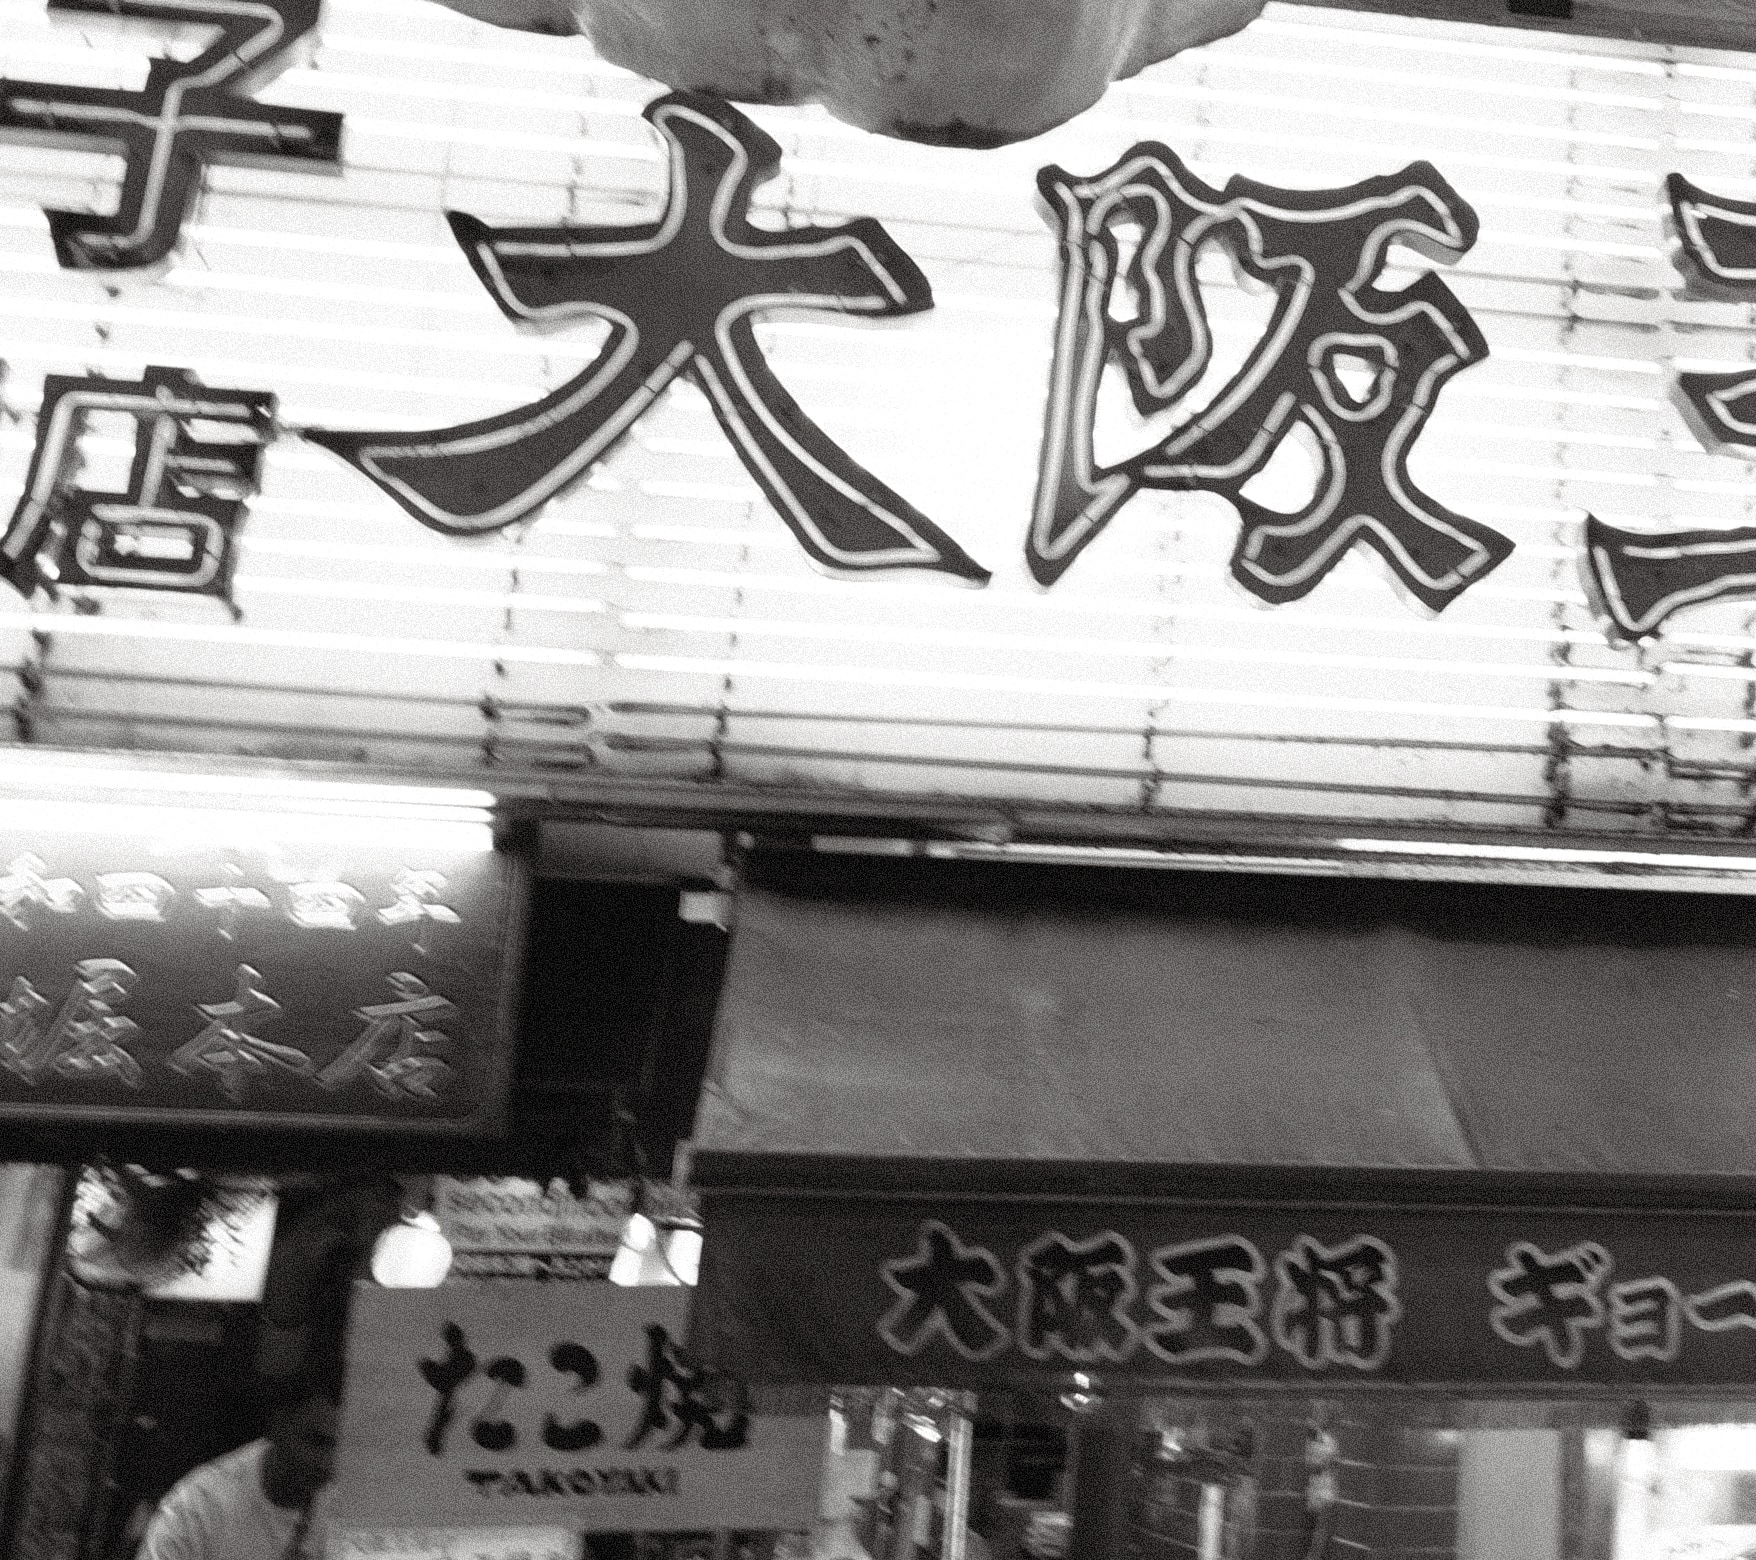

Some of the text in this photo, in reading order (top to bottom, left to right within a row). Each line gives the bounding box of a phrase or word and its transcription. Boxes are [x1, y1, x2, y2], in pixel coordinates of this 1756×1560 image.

[878, 1219, 1398, 1370] 大阪王将
[417, 1320, 750, 1457] たこ焼
